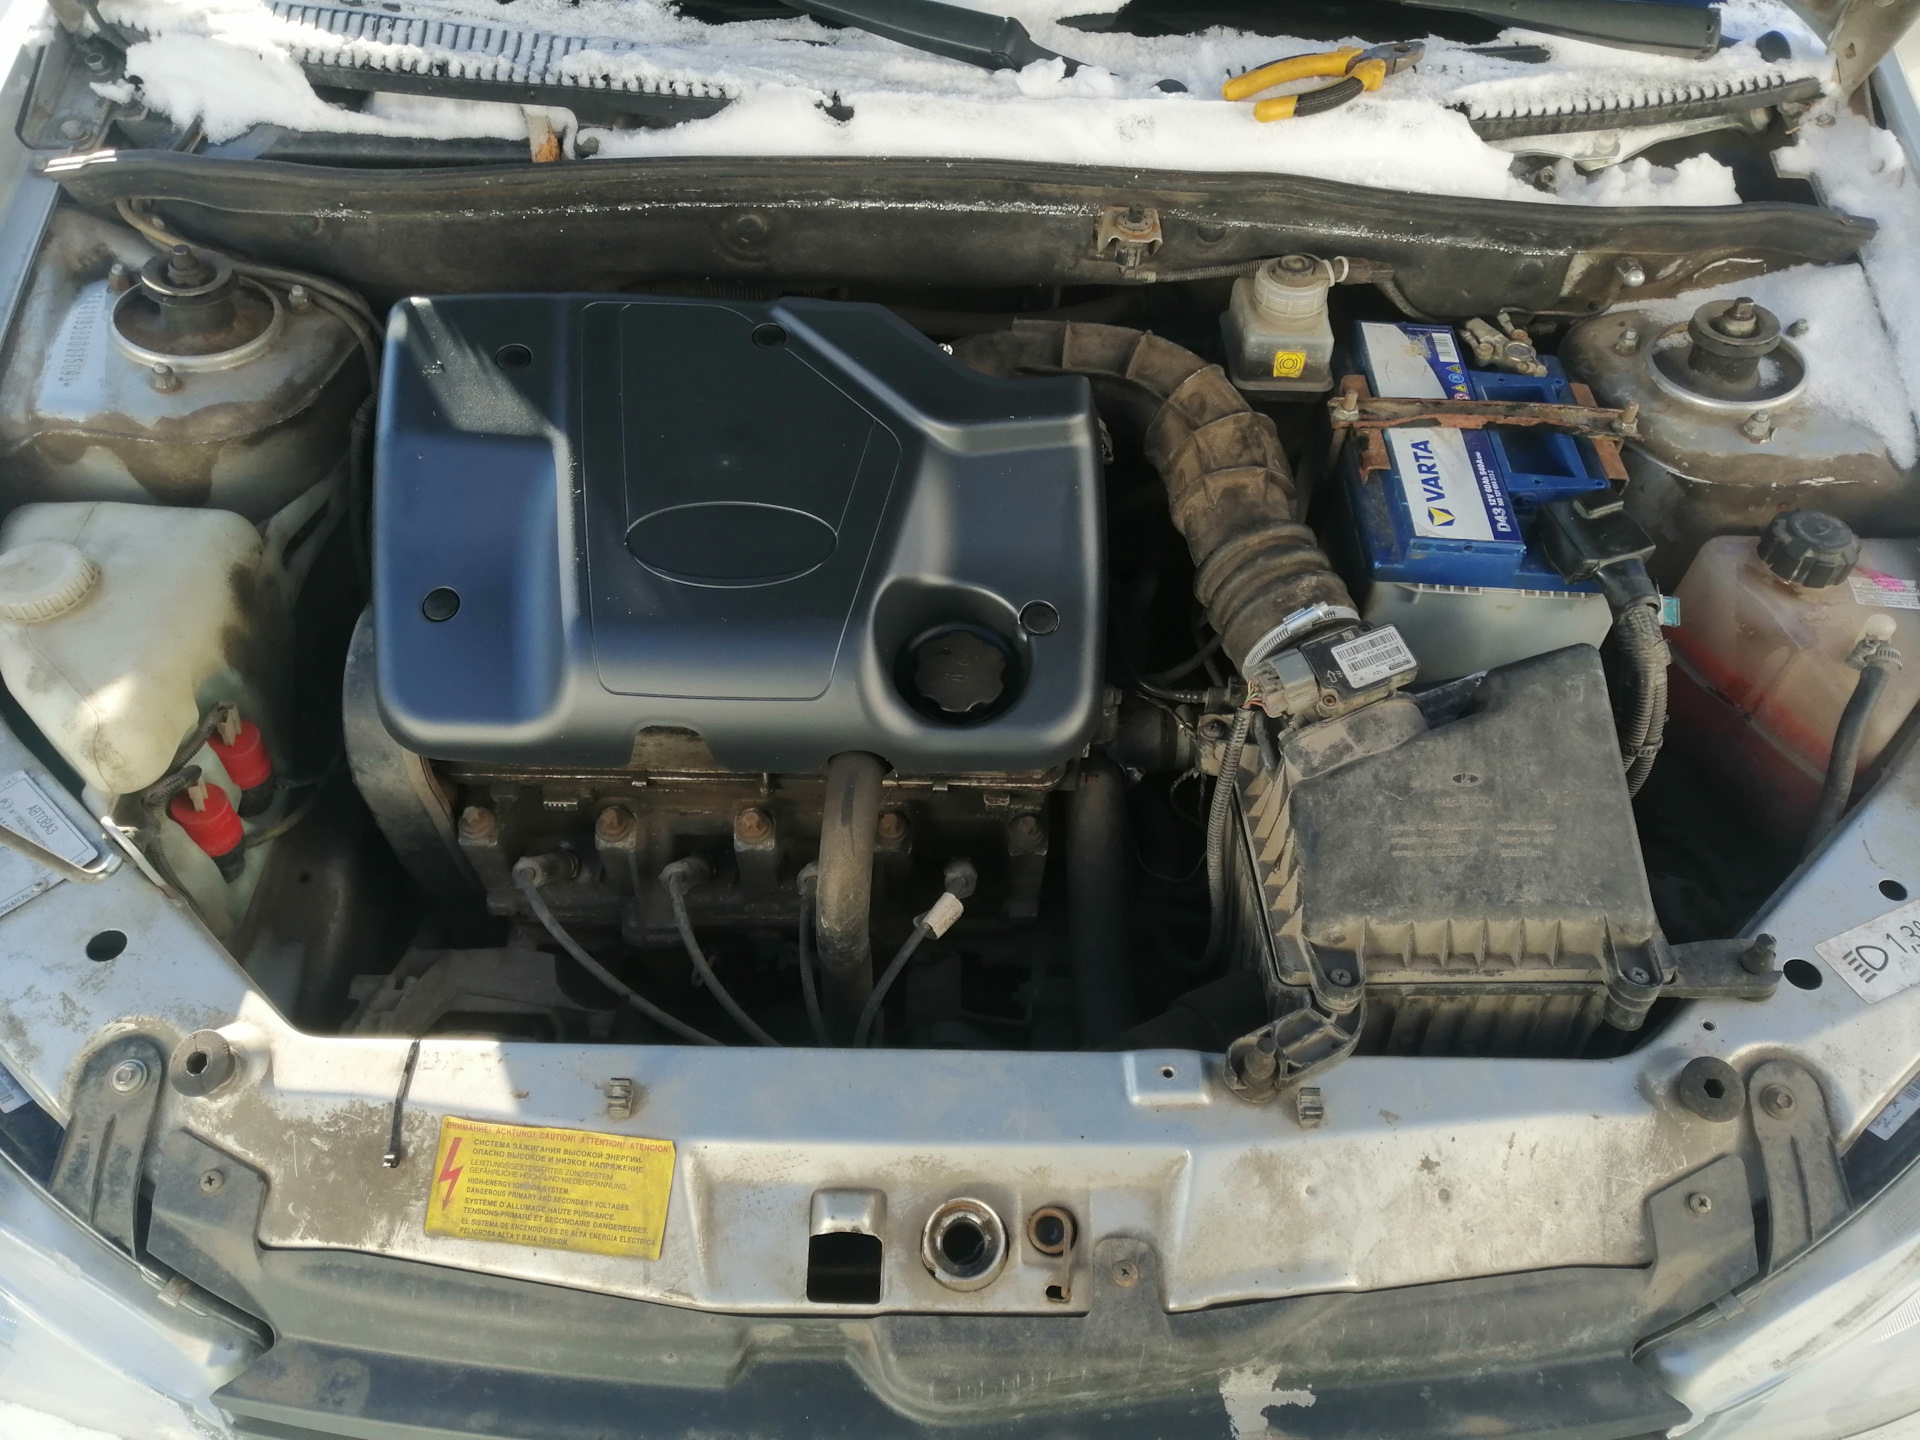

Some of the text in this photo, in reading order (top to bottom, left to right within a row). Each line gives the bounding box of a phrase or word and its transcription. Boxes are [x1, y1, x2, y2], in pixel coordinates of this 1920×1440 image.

[1410, 440, 1446, 502] VARTA
[1482, 476, 1493, 493] 60Ah
[1487, 493, 1497, 506] 12V
[1492, 507, 1512, 532] D43
[26, 804, 59, 835] АВТОВАЗ
[495, 1127, 535, 1138] ACHTUNG!
[539, 1132, 575, 1142] CAUTION!
[580, 1137, 625, 1148] ATTENTION!
[630, 1142, 670, 1153] ATENCION!
[472, 1148, 504, 1157] ОПАСНО
[507, 1152, 545, 1162] ВЫСОКОЕ
[556, 1158, 586, 1166] НИЗКОЕ
[473, 1139, 643, 1163] СИСТЕМА ЗАЖИГАНИЯ ВЫСОКОЙ ЭНЕРГИИ.
[471, 1159, 563, 1175] LEISTUNGSGESTEIGERTES
[468, 1177, 510, 1187] HIGH-ENERGY
[464, 1196, 497, 1206] SYSTÈME
[548, 1207, 571, 1215] HAUTE
[466, 1186, 505, 1196] DANGEROUS
[508, 1191, 536, 1200] PRIMARY
[553, 1197, 593, 1207] SECONDARY
[595, 1201, 630, 1211] VOLTAGES.
[471, 1219, 498, 1227] SISTEMA
[511, 1224, 546, 1233] ENCENDIDO
[589, 1233, 617, 1242] ENERGIA
[544, 1216, 591, 1227] SECONDAIRE
[592, 1222, 648, 1234] DANGEREUSES.
[460, 1227, 497, 1237] PELIGROSA
[539, 1237, 568, 1246] TENSION.
